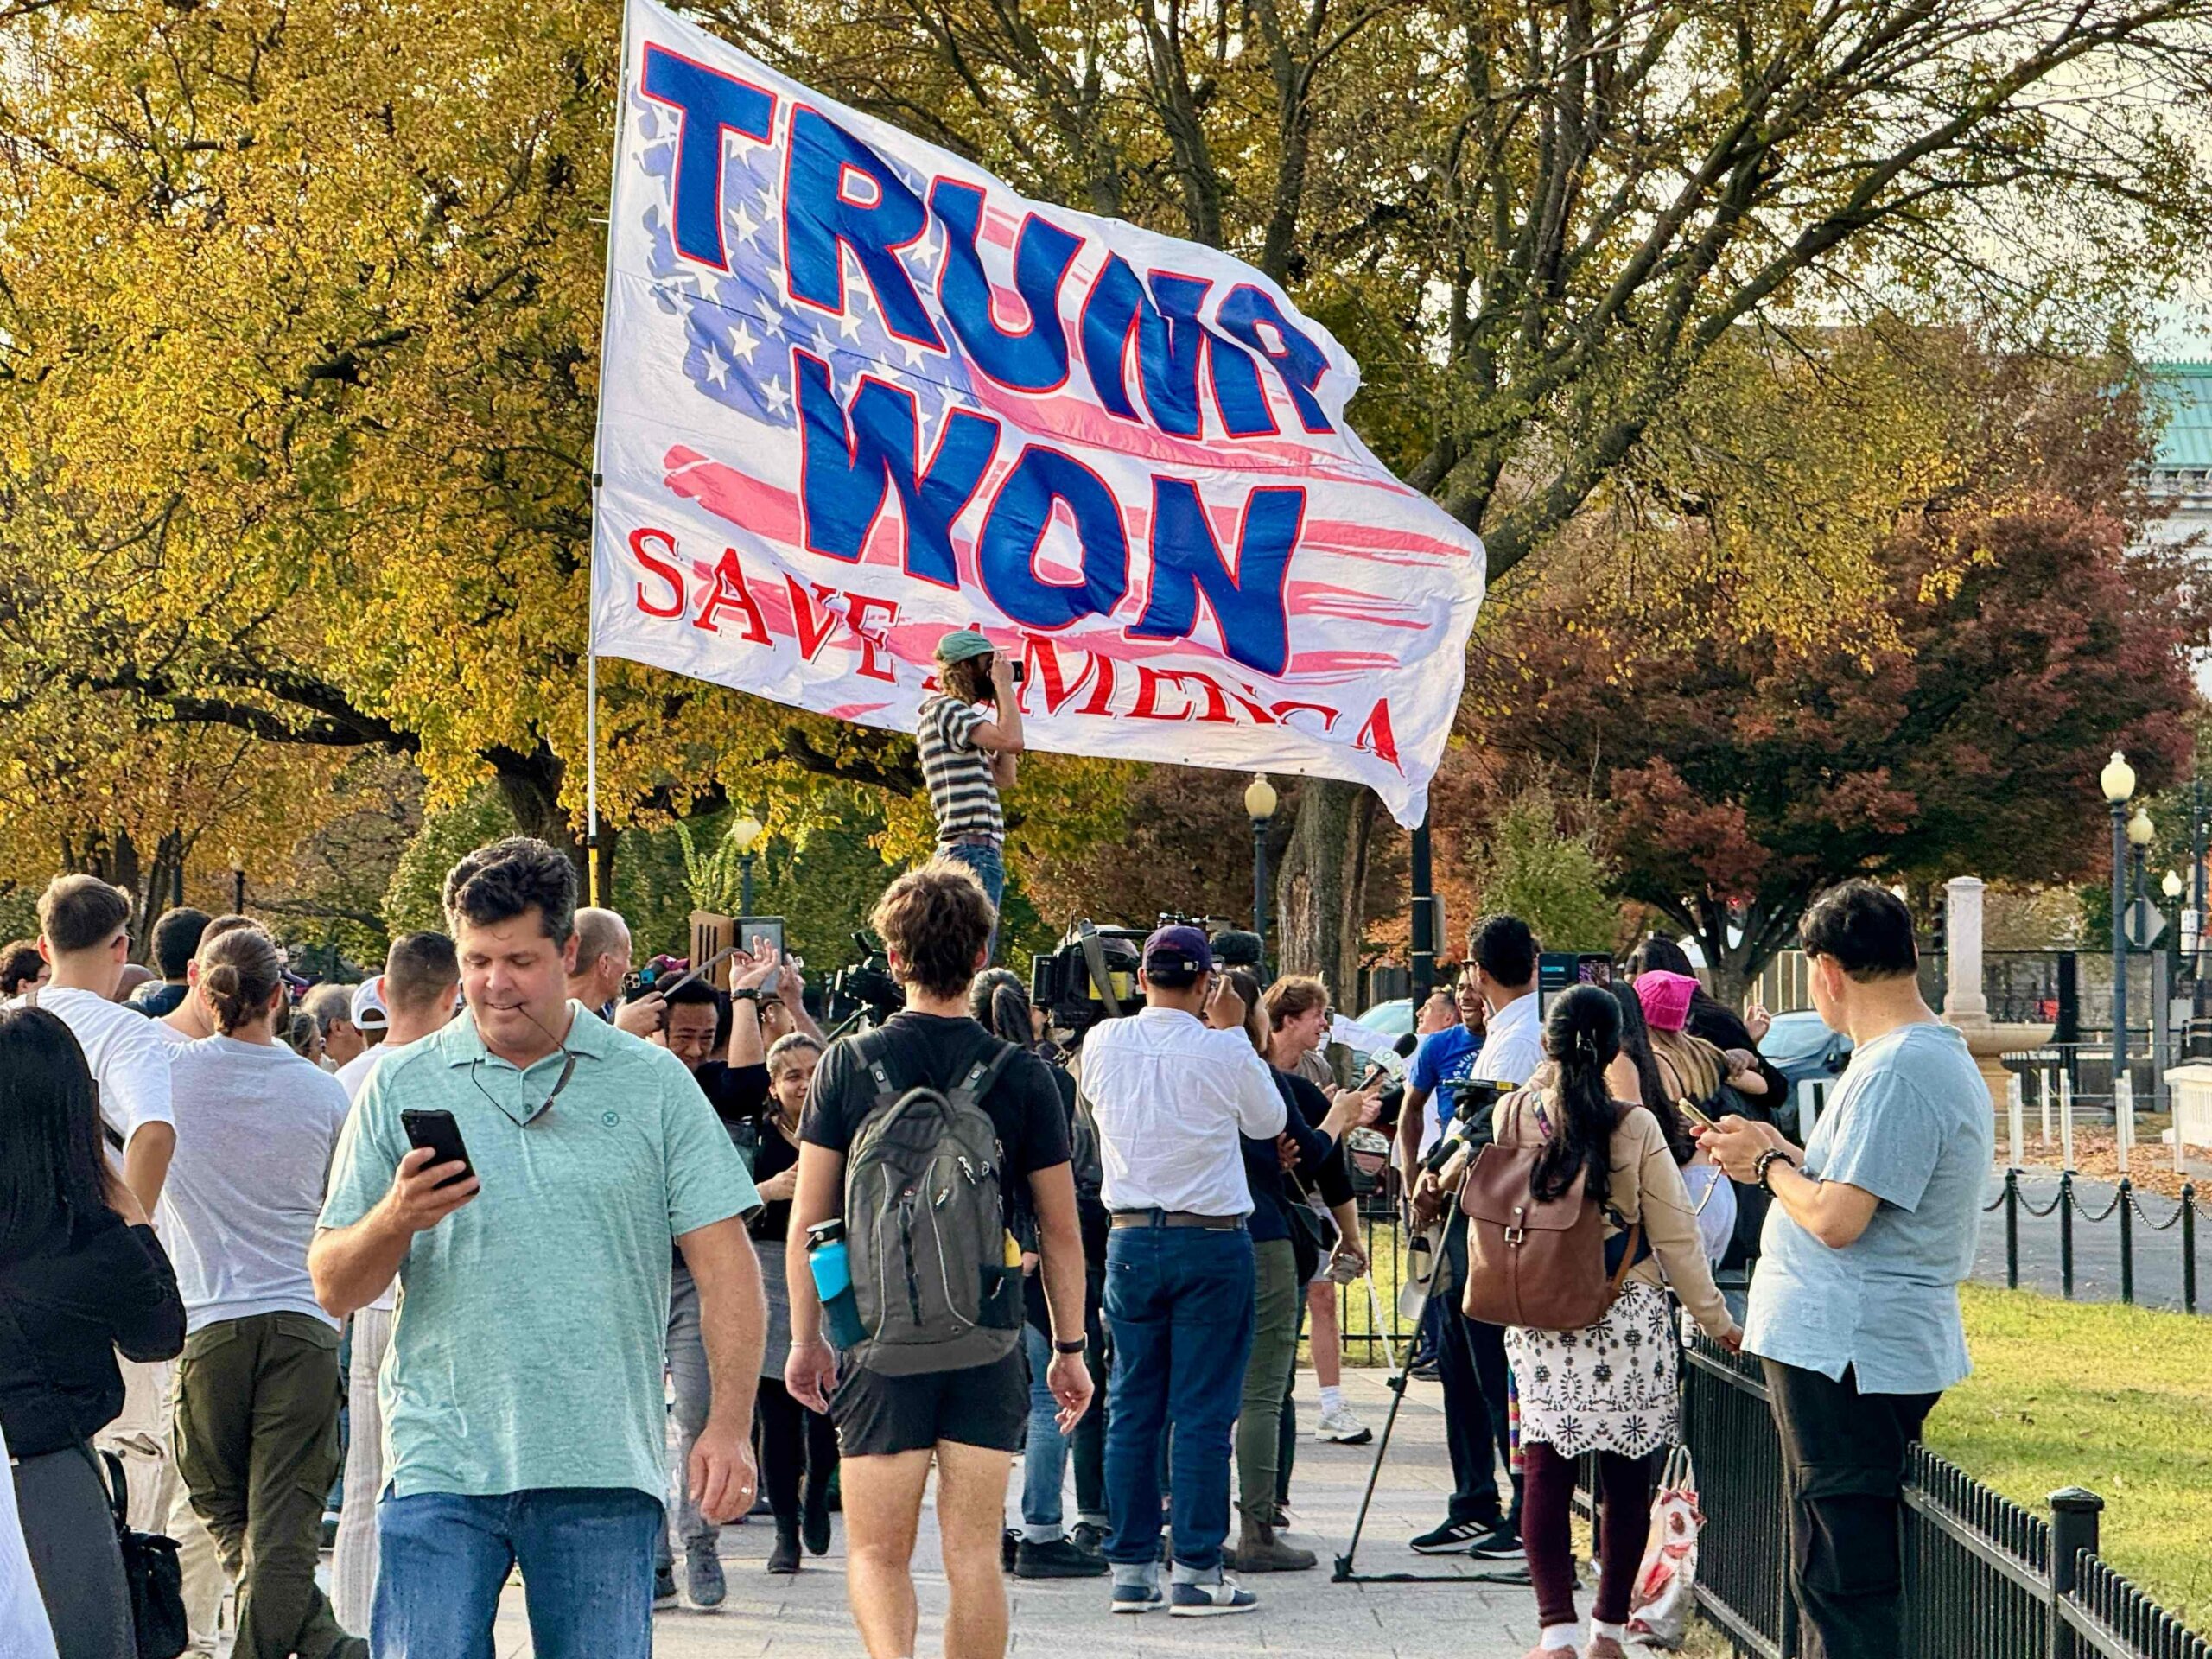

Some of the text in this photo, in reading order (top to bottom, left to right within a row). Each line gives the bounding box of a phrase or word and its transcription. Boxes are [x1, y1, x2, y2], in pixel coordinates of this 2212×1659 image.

[641, 41, 1337, 441] TRUMP
[629, 526, 1406, 779] SAVE MERA
[791, 347, 1307, 677] WON
